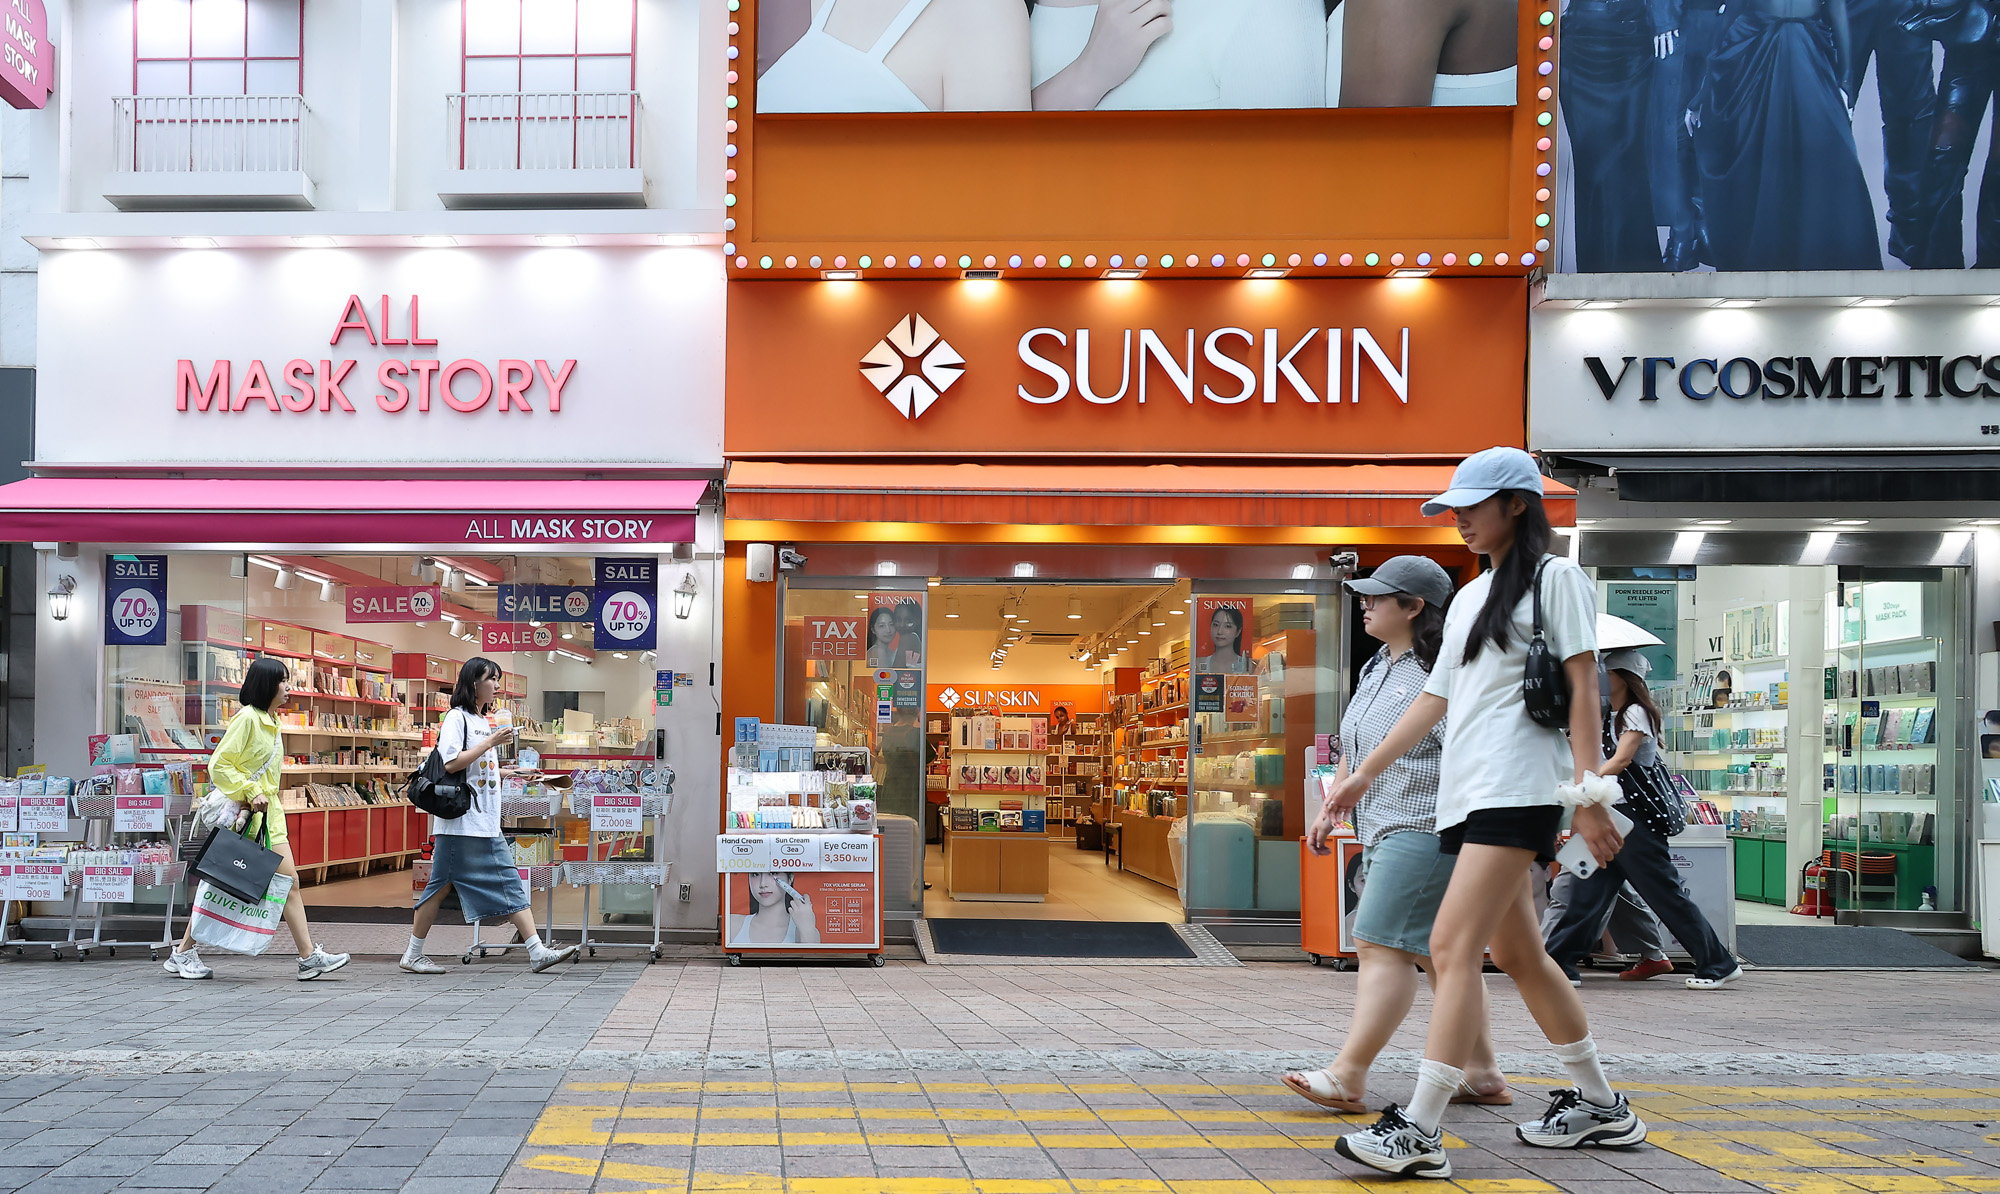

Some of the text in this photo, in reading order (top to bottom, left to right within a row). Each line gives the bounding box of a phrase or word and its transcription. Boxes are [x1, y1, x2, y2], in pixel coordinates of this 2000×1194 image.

[12, 0, 32, 24] ALL
[5, 12, 37, 58] MASK
[4, 42, 38, 86] STORY
[330, 294, 438, 346] ALL
[1017, 326, 1410, 404] SUNSKIN
[176, 358, 578, 412] MASK STORY
[1584, 356, 1676, 401] VT
[465, 519, 653, 539] ALL MASK STORY
[116, 564, 158, 576] SALE
[605, 566, 650, 579] SALE
[352, 597, 431, 614] SALE 70%
[504, 596, 586, 612] SALE 70%
[874, 596, 916, 605] SUNSKIN
[1204, 600, 1246, 609] SUNSKIN
[120, 598, 156, 618] 70%
[610, 601, 648, 622] 70%
[120, 619, 152, 628] UP TO
[1875, 613, 1890, 621] MASK
[610, 622, 644, 631] UP TO
[812, 622, 857, 638] TAX
[278, 635, 288, 644] BEST
[487, 631, 531, 645] SALE
[812, 642, 857, 656] FREE
[1525, 678, 1543, 689] NY
[964, 690, 1040, 706] SUNSKIN
[1532, 710, 1550, 718] NY
[824, 842, 839, 851] Eye
[233, 859, 247, 869] alo
[720, 859, 751, 870] 1,000
[772, 859, 801, 869] 9,900
[824, 854, 851, 863] 3,350
[27, 890, 50, 898] 900원
[203, 891, 269, 919] OLIVE YOUNG
[1394, 1136, 1412, 1155] NY
